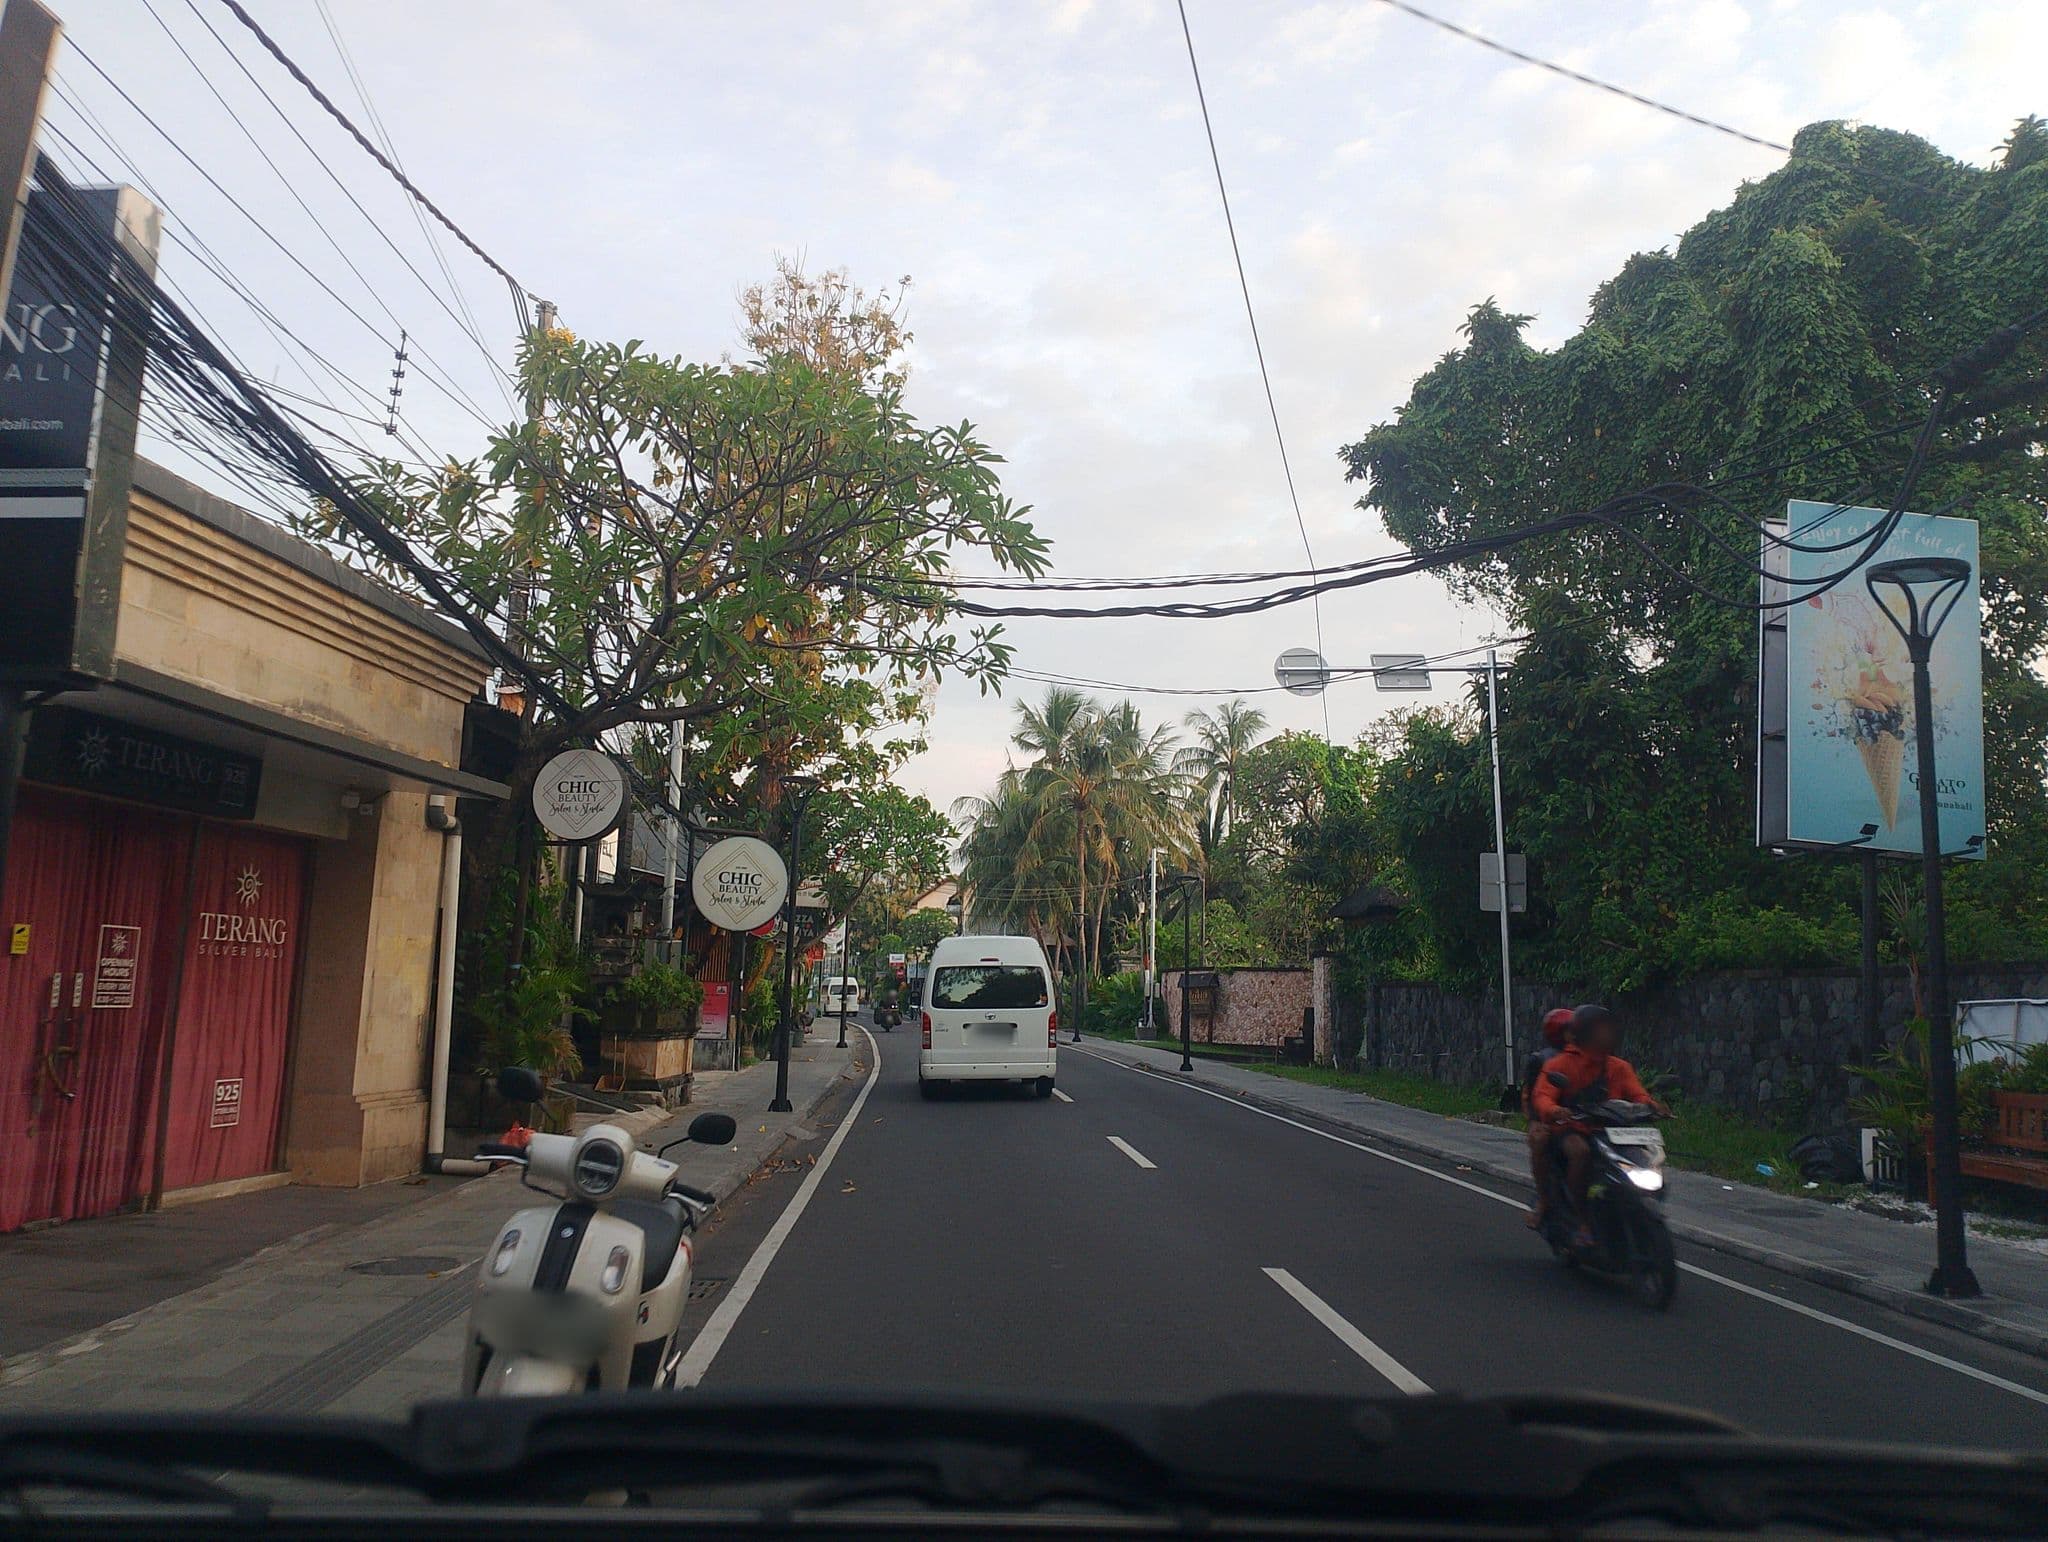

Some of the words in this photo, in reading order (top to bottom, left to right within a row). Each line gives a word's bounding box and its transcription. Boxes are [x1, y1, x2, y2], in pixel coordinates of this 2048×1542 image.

[119, 736, 213, 784] TERANG
[557, 780, 602, 794] CHIC
[1908, 772, 1967, 789] GATO
[1914, 778, 1956, 795] ILIA
[558, 793, 600, 803] BEAUTY
[718, 871, 763, 887] CHIC
[719, 884, 760, 895] BEAUTY
[200, 912, 288, 945] TERANG
[199, 944, 247, 958] SILVER
[255, 947, 285, 960] BALI
[216, 1084, 240, 1102] 925
